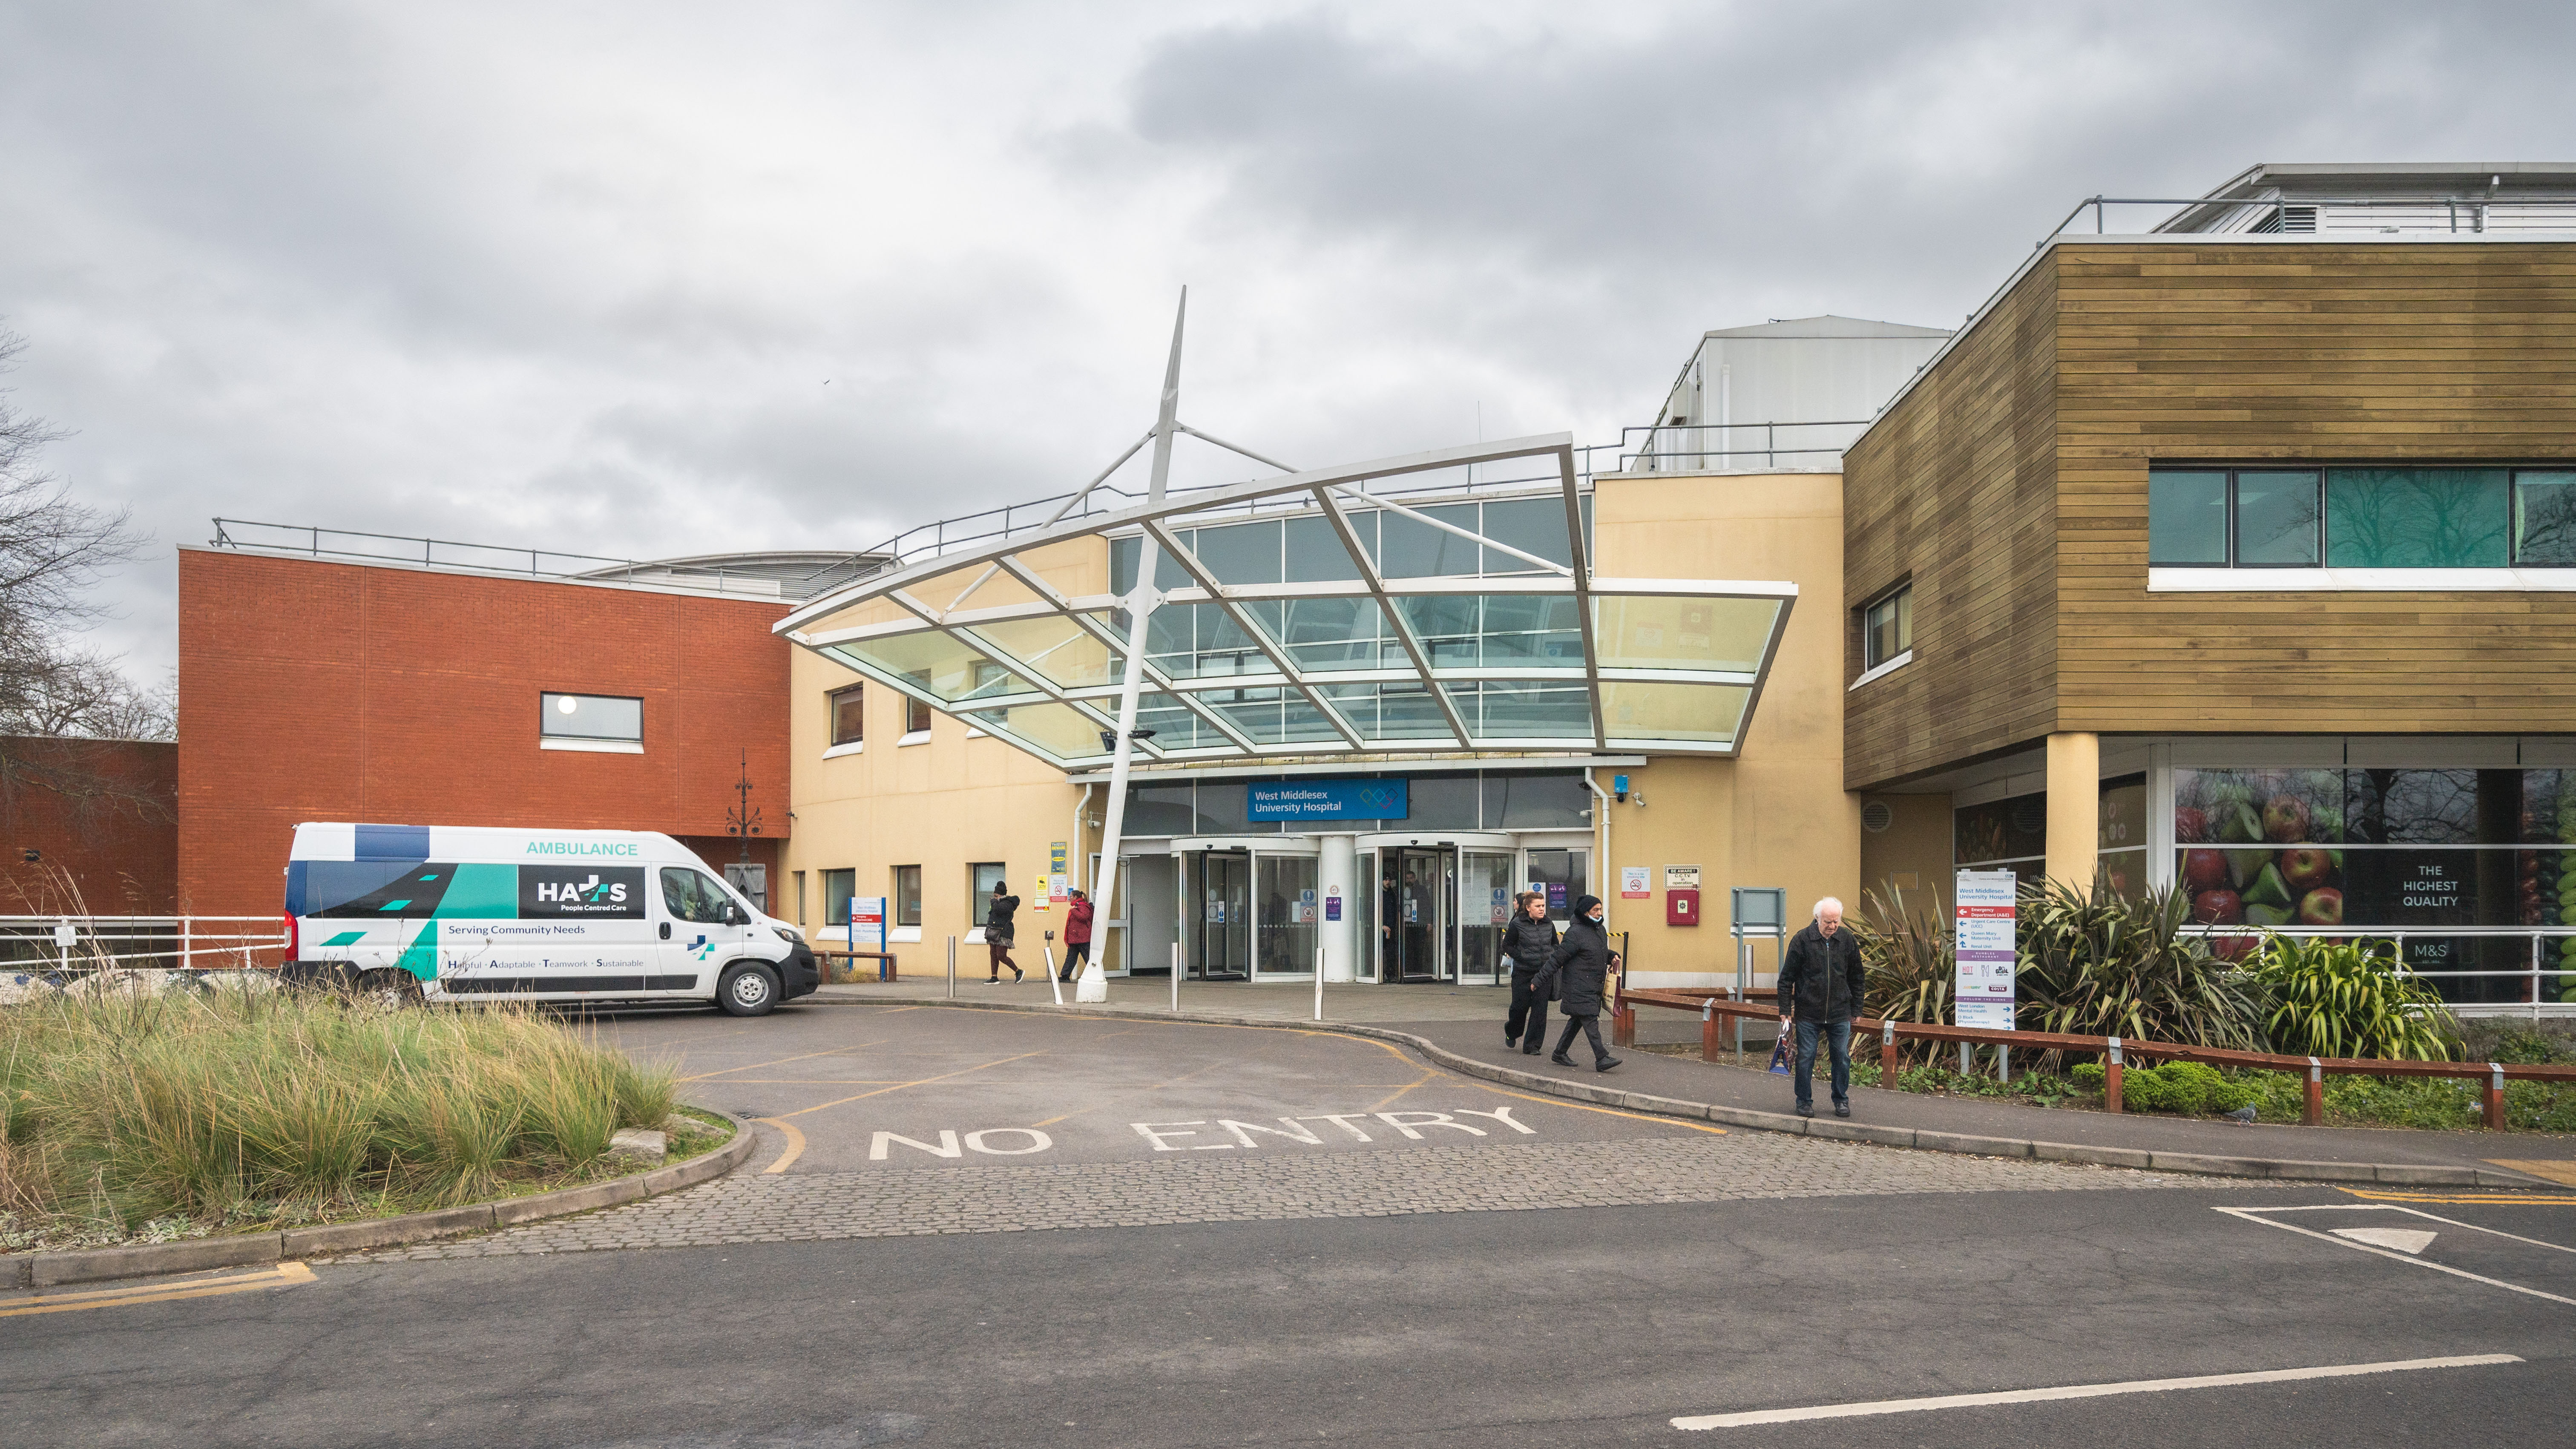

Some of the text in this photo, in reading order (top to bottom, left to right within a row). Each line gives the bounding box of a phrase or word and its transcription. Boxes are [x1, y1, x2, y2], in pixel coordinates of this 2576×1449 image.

[1255, 790, 1328, 800] West Middlesex
[1255, 801, 1341, 814] University Hospital
[526, 842, 638, 856] AMBULANCE
[2418, 865, 2442, 875] THE
[2404, 881, 2458, 891] HIGHEST
[2403, 896, 2458, 906] QUALITY
[448, 926, 585, 935] Serving Community Needs
[2415, 945, 2446, 957] M&S
[489, 960, 535, 969] Adaptable
[542, 959, 588, 967] Teamwork
[596, 959, 644, 967] Sustainable
[869, 1107, 1538, 1160] NO ENTRY
